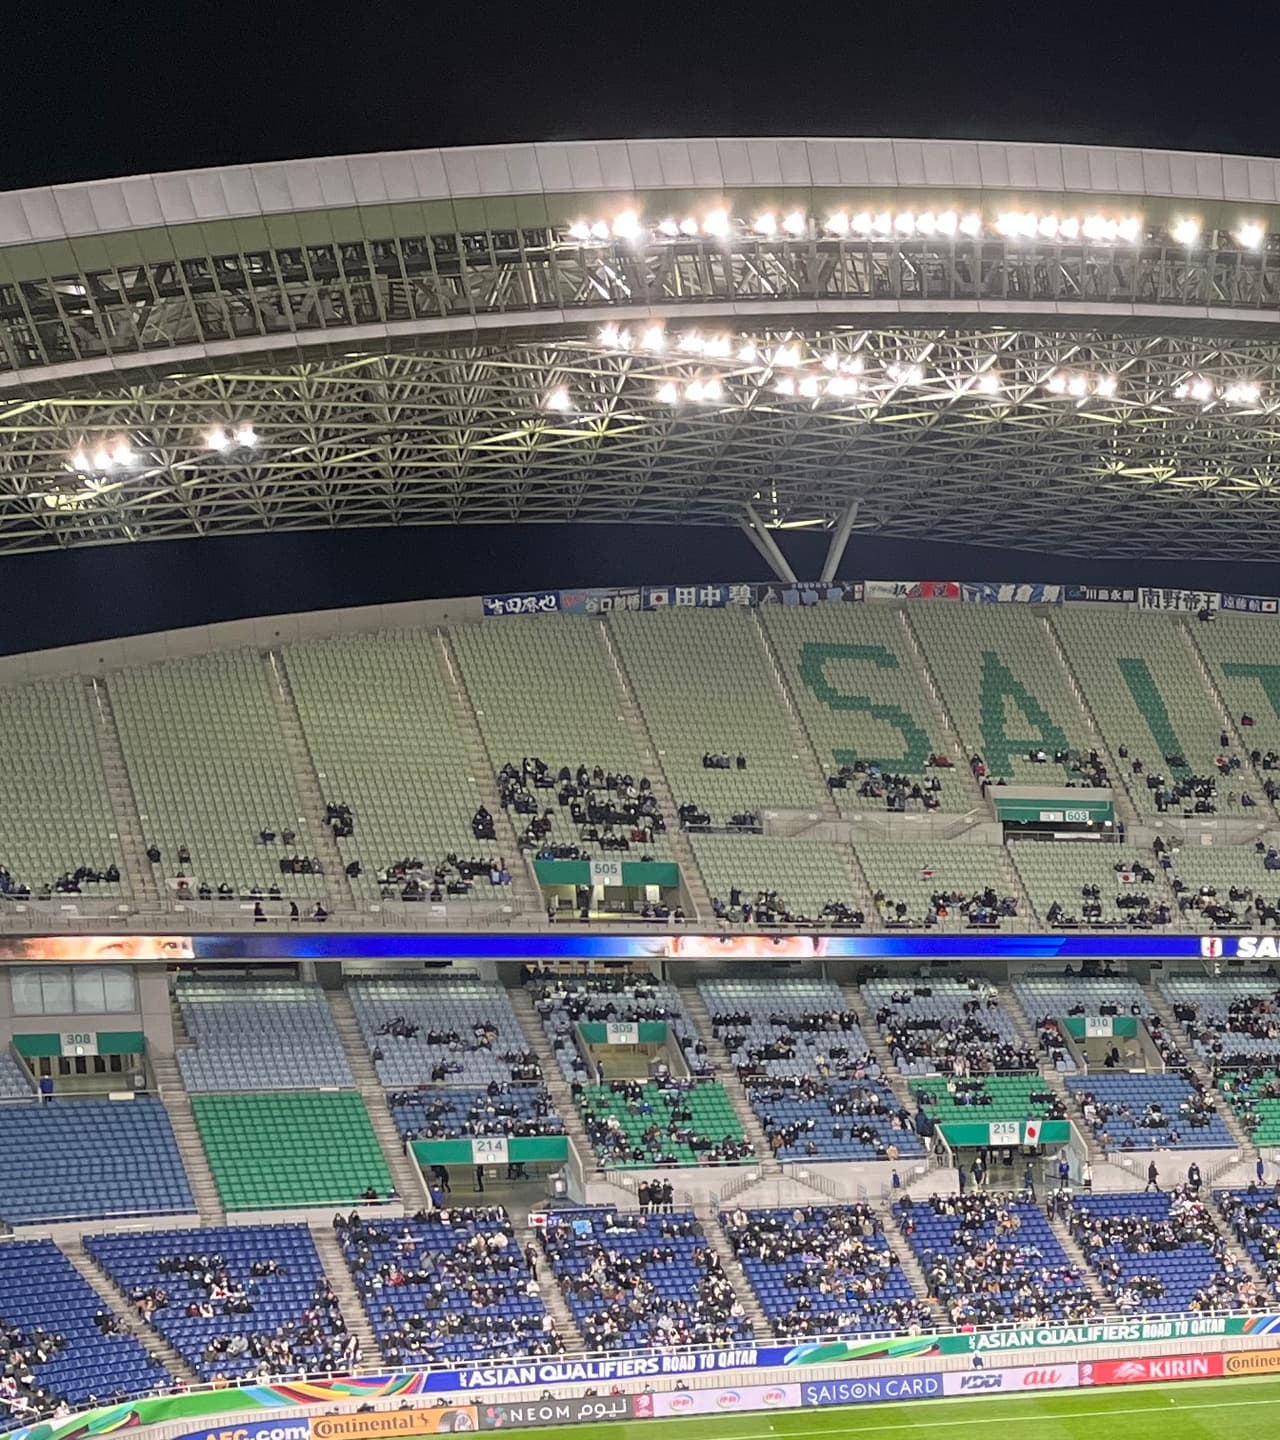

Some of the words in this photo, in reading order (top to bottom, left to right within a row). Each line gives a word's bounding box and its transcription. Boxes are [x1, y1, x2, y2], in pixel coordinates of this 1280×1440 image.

[1067, 811, 1090, 821] 603
[594, 863, 618, 874] 505
[612, 1022, 633, 1034] 309
[1090, 1018, 1108, 1028] 310
[67, 1032, 91, 1044] 308
[993, 1124, 1016, 1134] 215
[477, 1140, 504, 1152] 214
[978, 1331, 1030, 1350] ASIAN
[1036, 1323, 1140, 1345] QUALIFIERS
[1143, 1322, 1171, 1338] ROAD
[1175, 1321, 1188, 1336] TO
[1190, 1318, 1225, 1335] QATAR
[469, 1367, 536, 1387] ASIAN
[540, 1357, 659, 1381] QUALIFIERS
[663, 1353, 697, 1372] ROAD
[700, 1352, 715, 1370] TO
[718, 1350, 757, 1368] QATAR
[1151, 1357, 1209, 1377] KIRIN
[960, 1374, 1002, 1390] KDDI
[1023, 1369, 1062, 1386] au
[807, 1382, 880, 1402] SAISON
[890, 1378, 939, 1397] CARD
[511, 1405, 570, 1423] NEOM
[577, 1398, 627, 1422] نيوم
[313, 1415, 414, 1439] Continental
